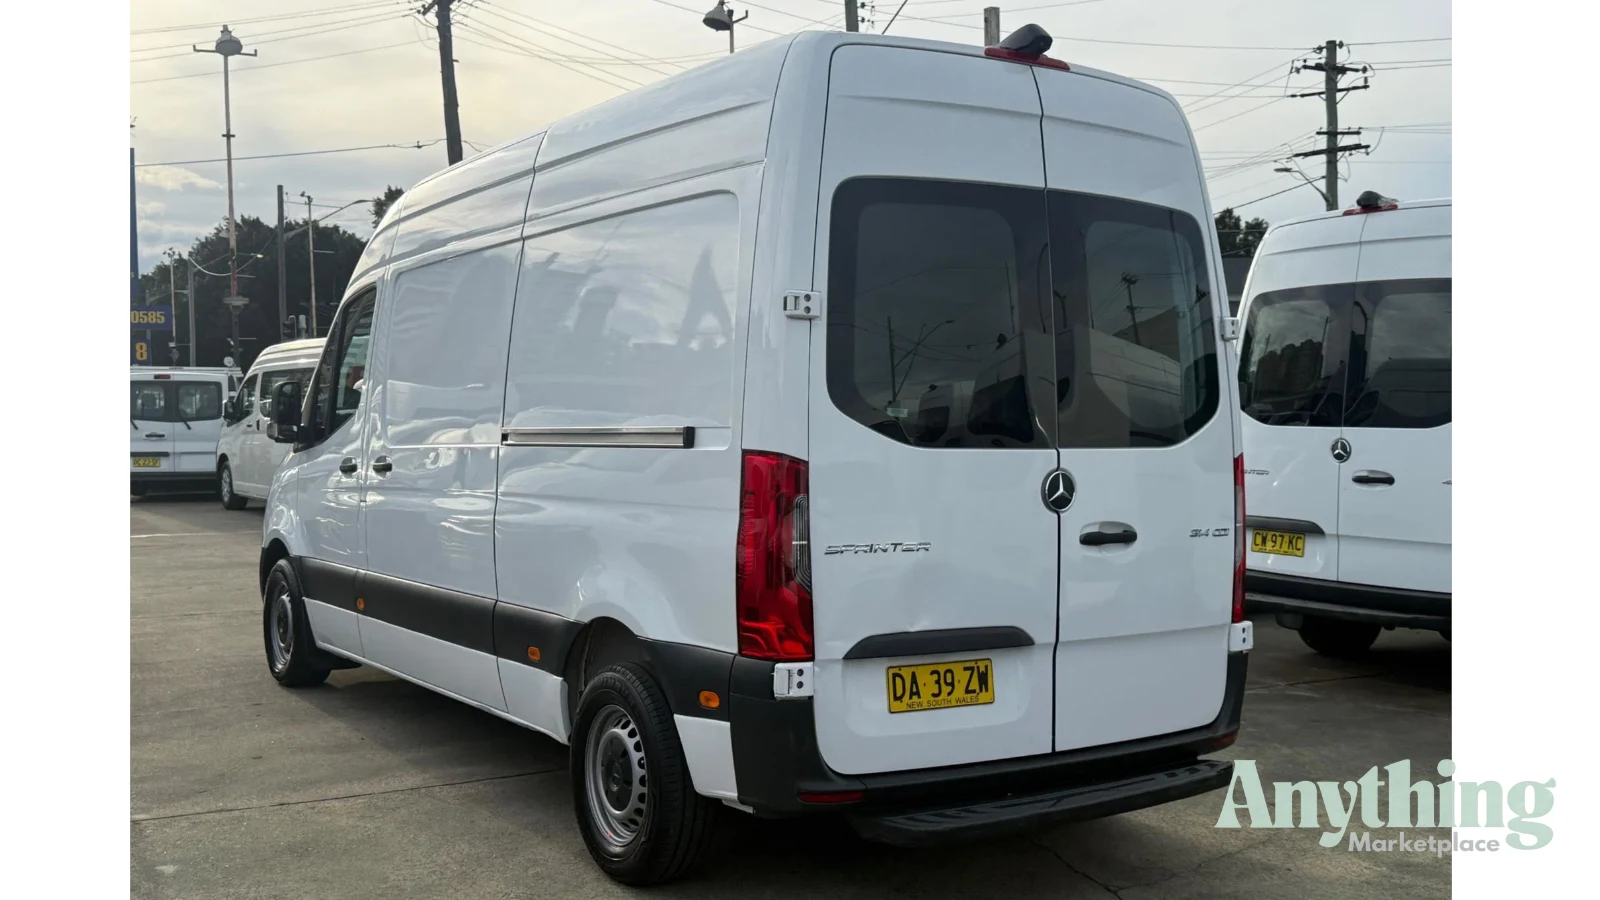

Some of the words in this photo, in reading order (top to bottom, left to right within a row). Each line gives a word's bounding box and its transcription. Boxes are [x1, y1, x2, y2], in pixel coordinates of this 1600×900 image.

[824, 542, 931, 555] SPRINTER
[1271, 534, 1284, 549] 97
[1288, 535, 1302, 551] KC
[892, 671, 921, 701] DA
[930, 669, 955, 698] 39
[963, 665, 988, 695] ZW
[906, 700, 923, 709] NEW
[927, 698, 952, 707] SOUTH
[956, 695, 979, 704] WALES
